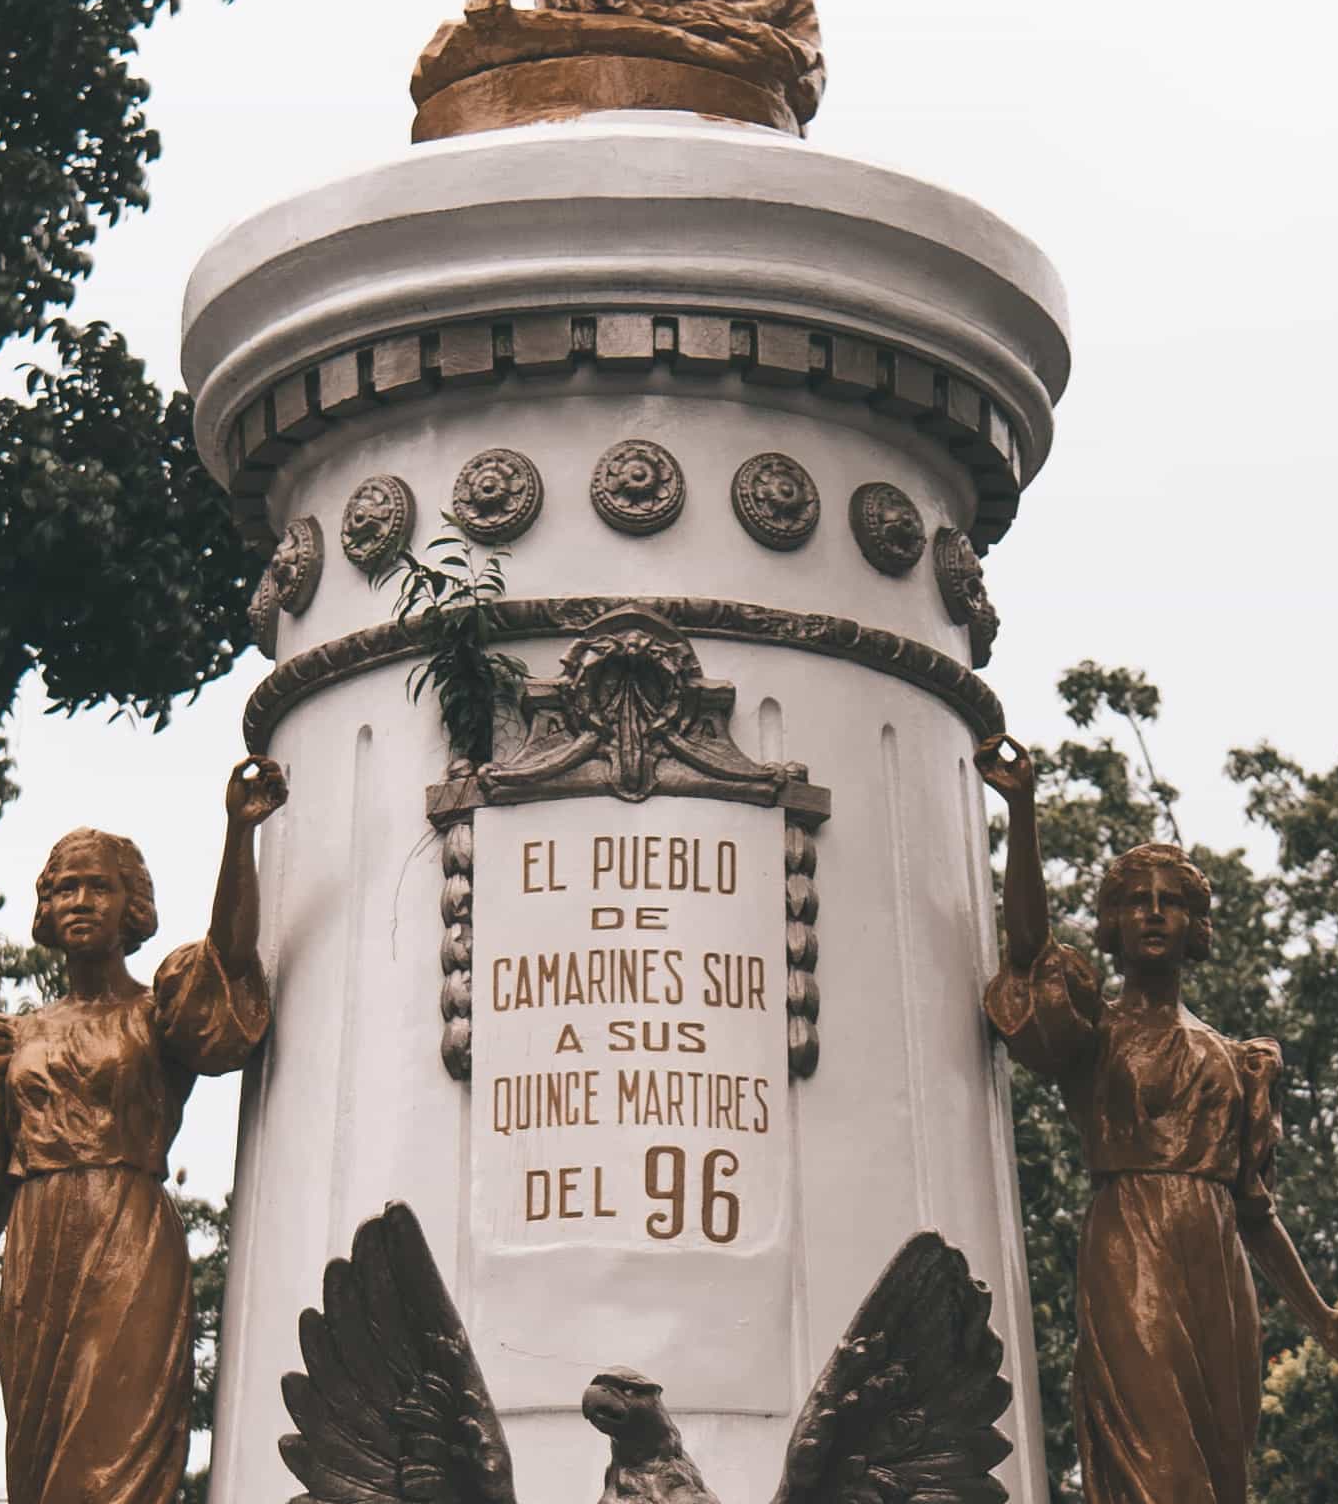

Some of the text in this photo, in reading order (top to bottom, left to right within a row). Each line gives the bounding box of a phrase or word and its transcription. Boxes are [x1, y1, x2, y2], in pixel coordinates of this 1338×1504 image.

[524, 836, 736, 895] EL PUEBLO
[591, 907, 669, 930] DE
[493, 949, 766, 1012] CAMARINES SUR
[556, 1021, 706, 1054] A SUS
[494, 1070, 769, 1136] QUINCE MARTIRES
[526, 1146, 739, 1243] DEL 96
